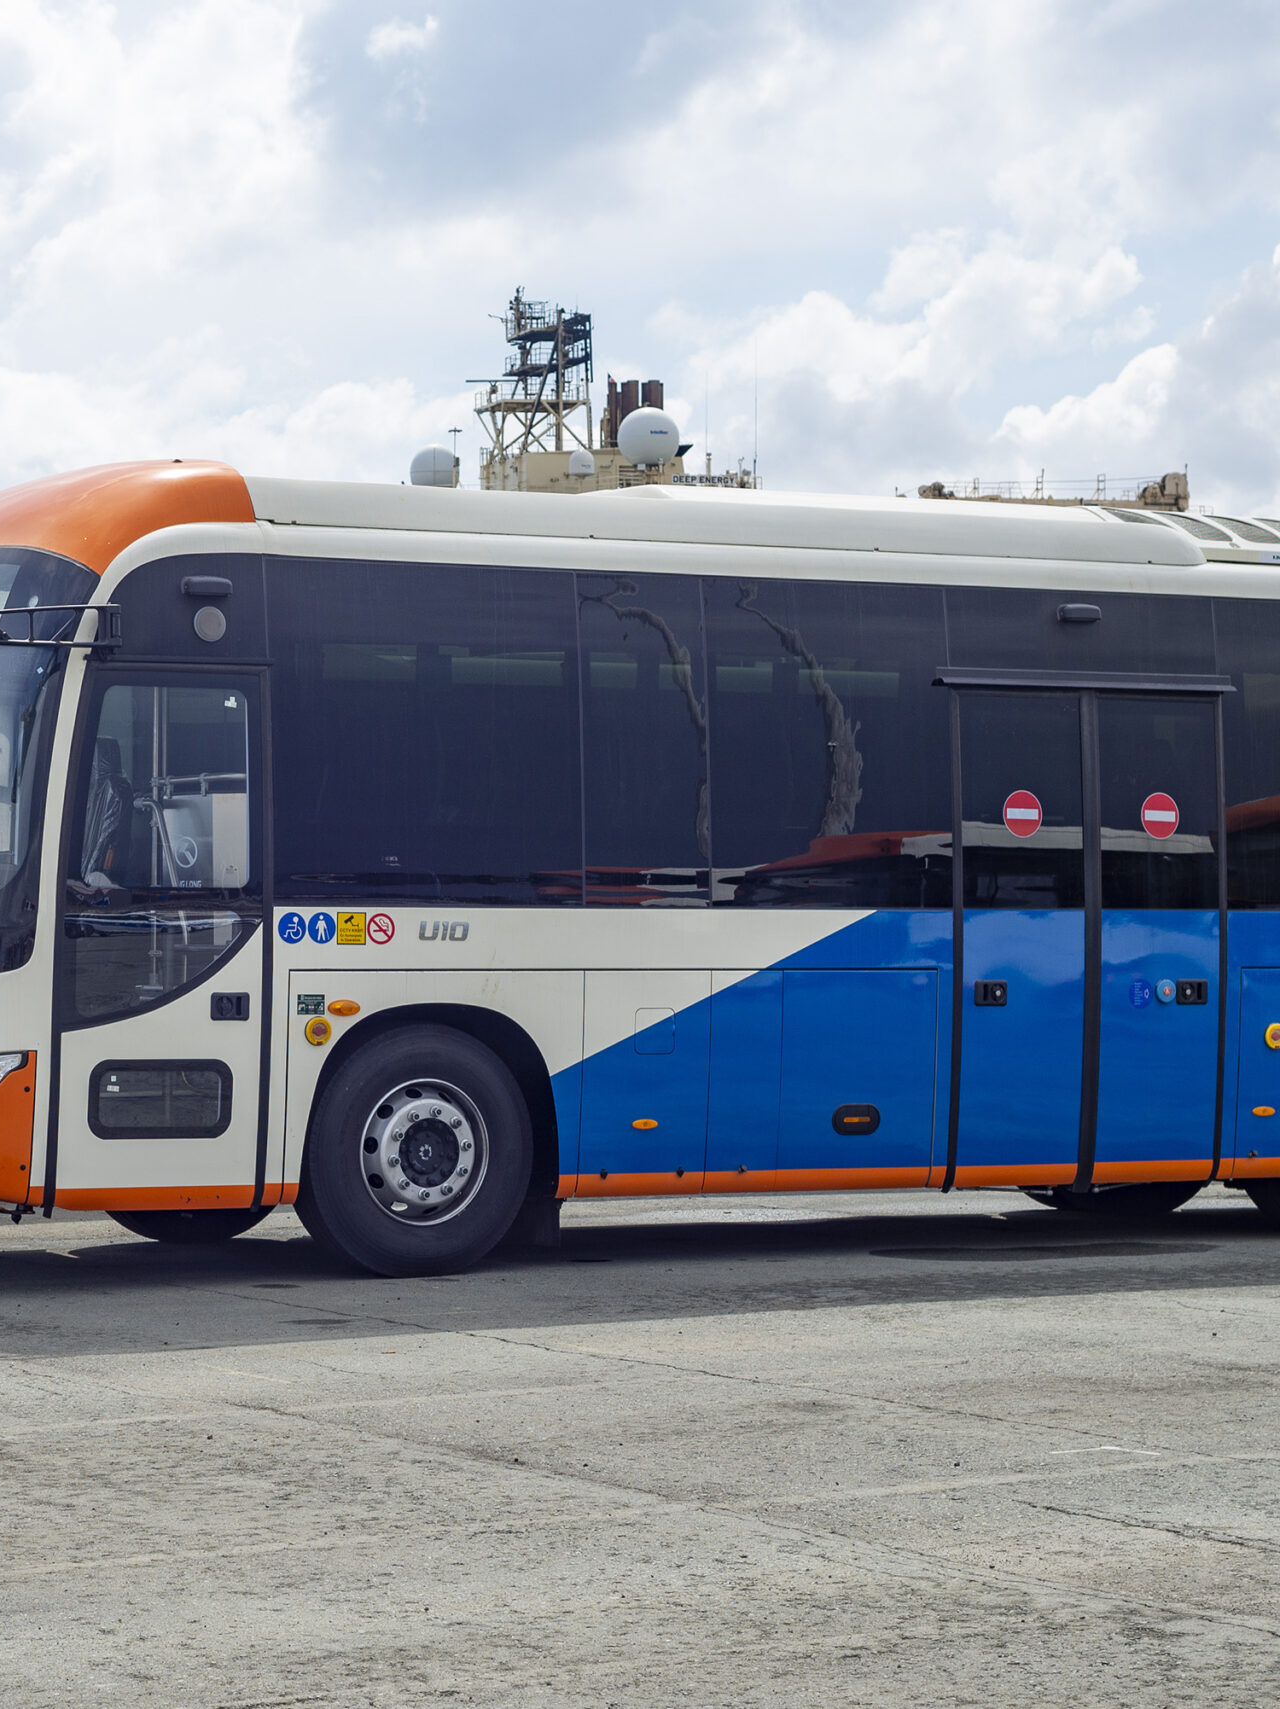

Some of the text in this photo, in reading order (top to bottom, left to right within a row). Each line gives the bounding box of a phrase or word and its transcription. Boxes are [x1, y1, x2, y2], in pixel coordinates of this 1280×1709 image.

[673, 475, 734, 484] DEEP ENERGY
[418, 920, 470, 941] U10
